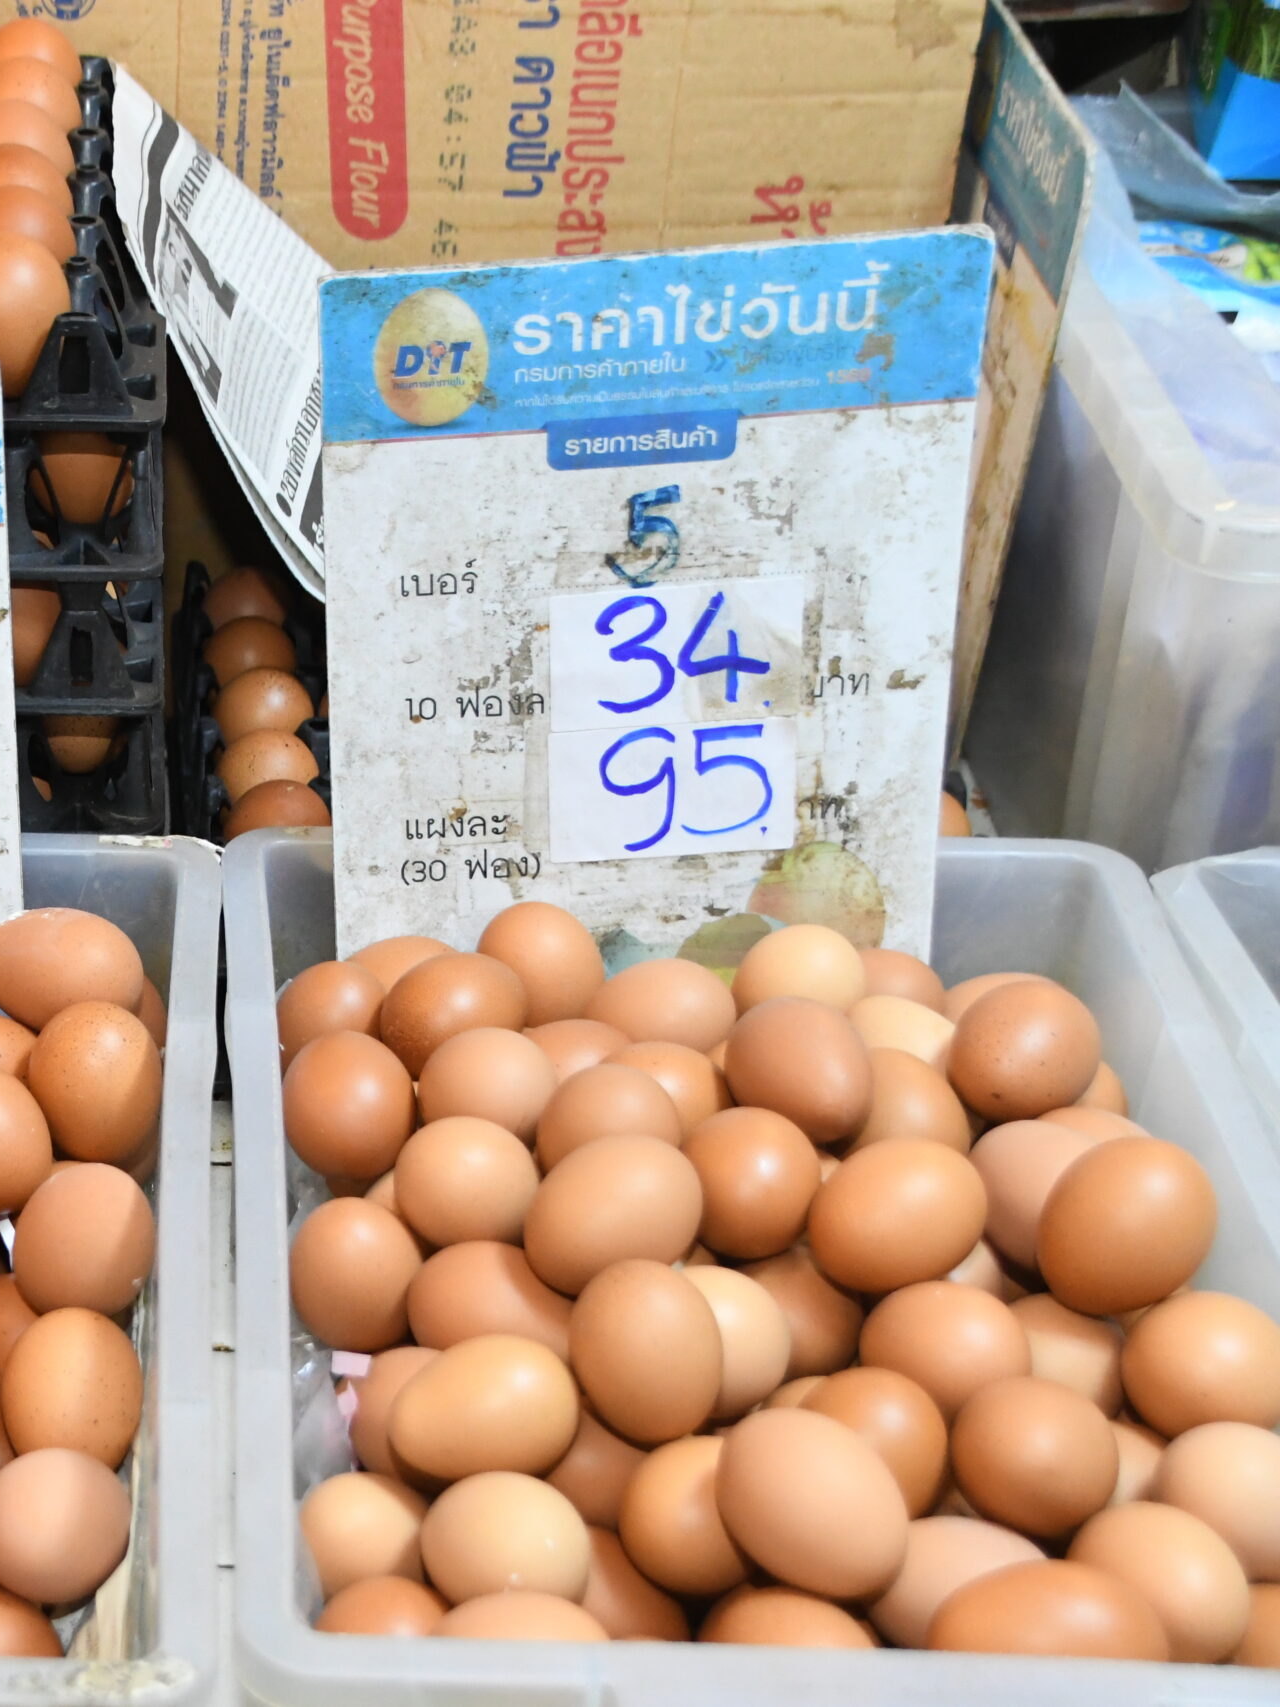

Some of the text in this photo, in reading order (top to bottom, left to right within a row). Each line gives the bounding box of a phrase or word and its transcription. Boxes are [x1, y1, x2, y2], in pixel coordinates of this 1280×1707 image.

[502, 56, 562, 198] ดาวฟ้า
[347, 135, 392, 230] Flour
[512, 261, 890, 356] ราคาไข่วันนี้
[514, 351, 687, 384] กรมการค้าภายใน
[564, 428, 718, 457] รายการสินค้า
[605, 484, 681, 588] 5
[400, 558, 478, 597] เบอร์
[405, 698, 437, 719] 10
[405, 814, 508, 840] แผงละ
[401, 848, 542, 885] (30 ฟอง)
